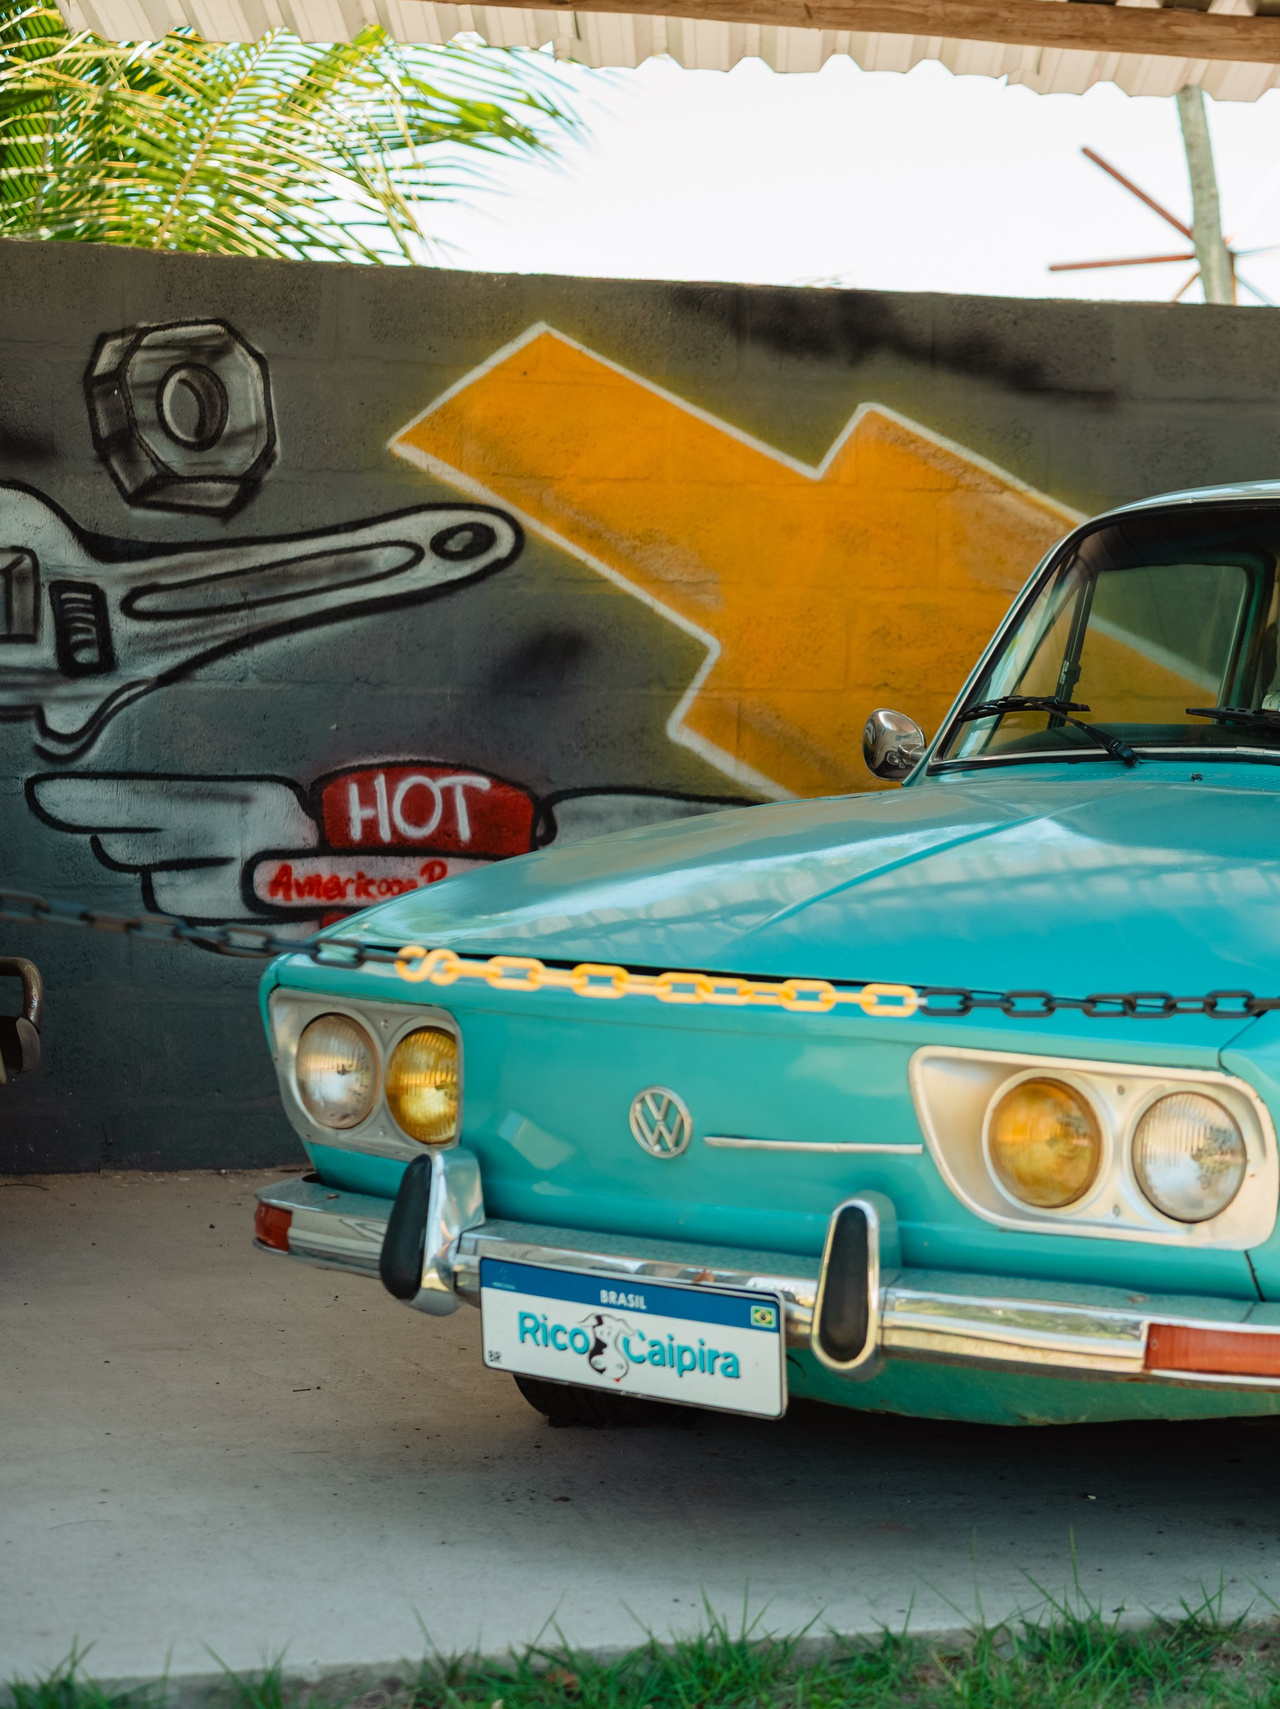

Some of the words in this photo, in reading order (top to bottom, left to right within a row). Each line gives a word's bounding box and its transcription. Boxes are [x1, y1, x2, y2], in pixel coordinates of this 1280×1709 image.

[348, 772, 491, 843] HOT
[600, 1289, 647, 1310] BRASIL
[518, 1311, 589, 1354] Rico
[622, 1328, 740, 1378] Caipira
